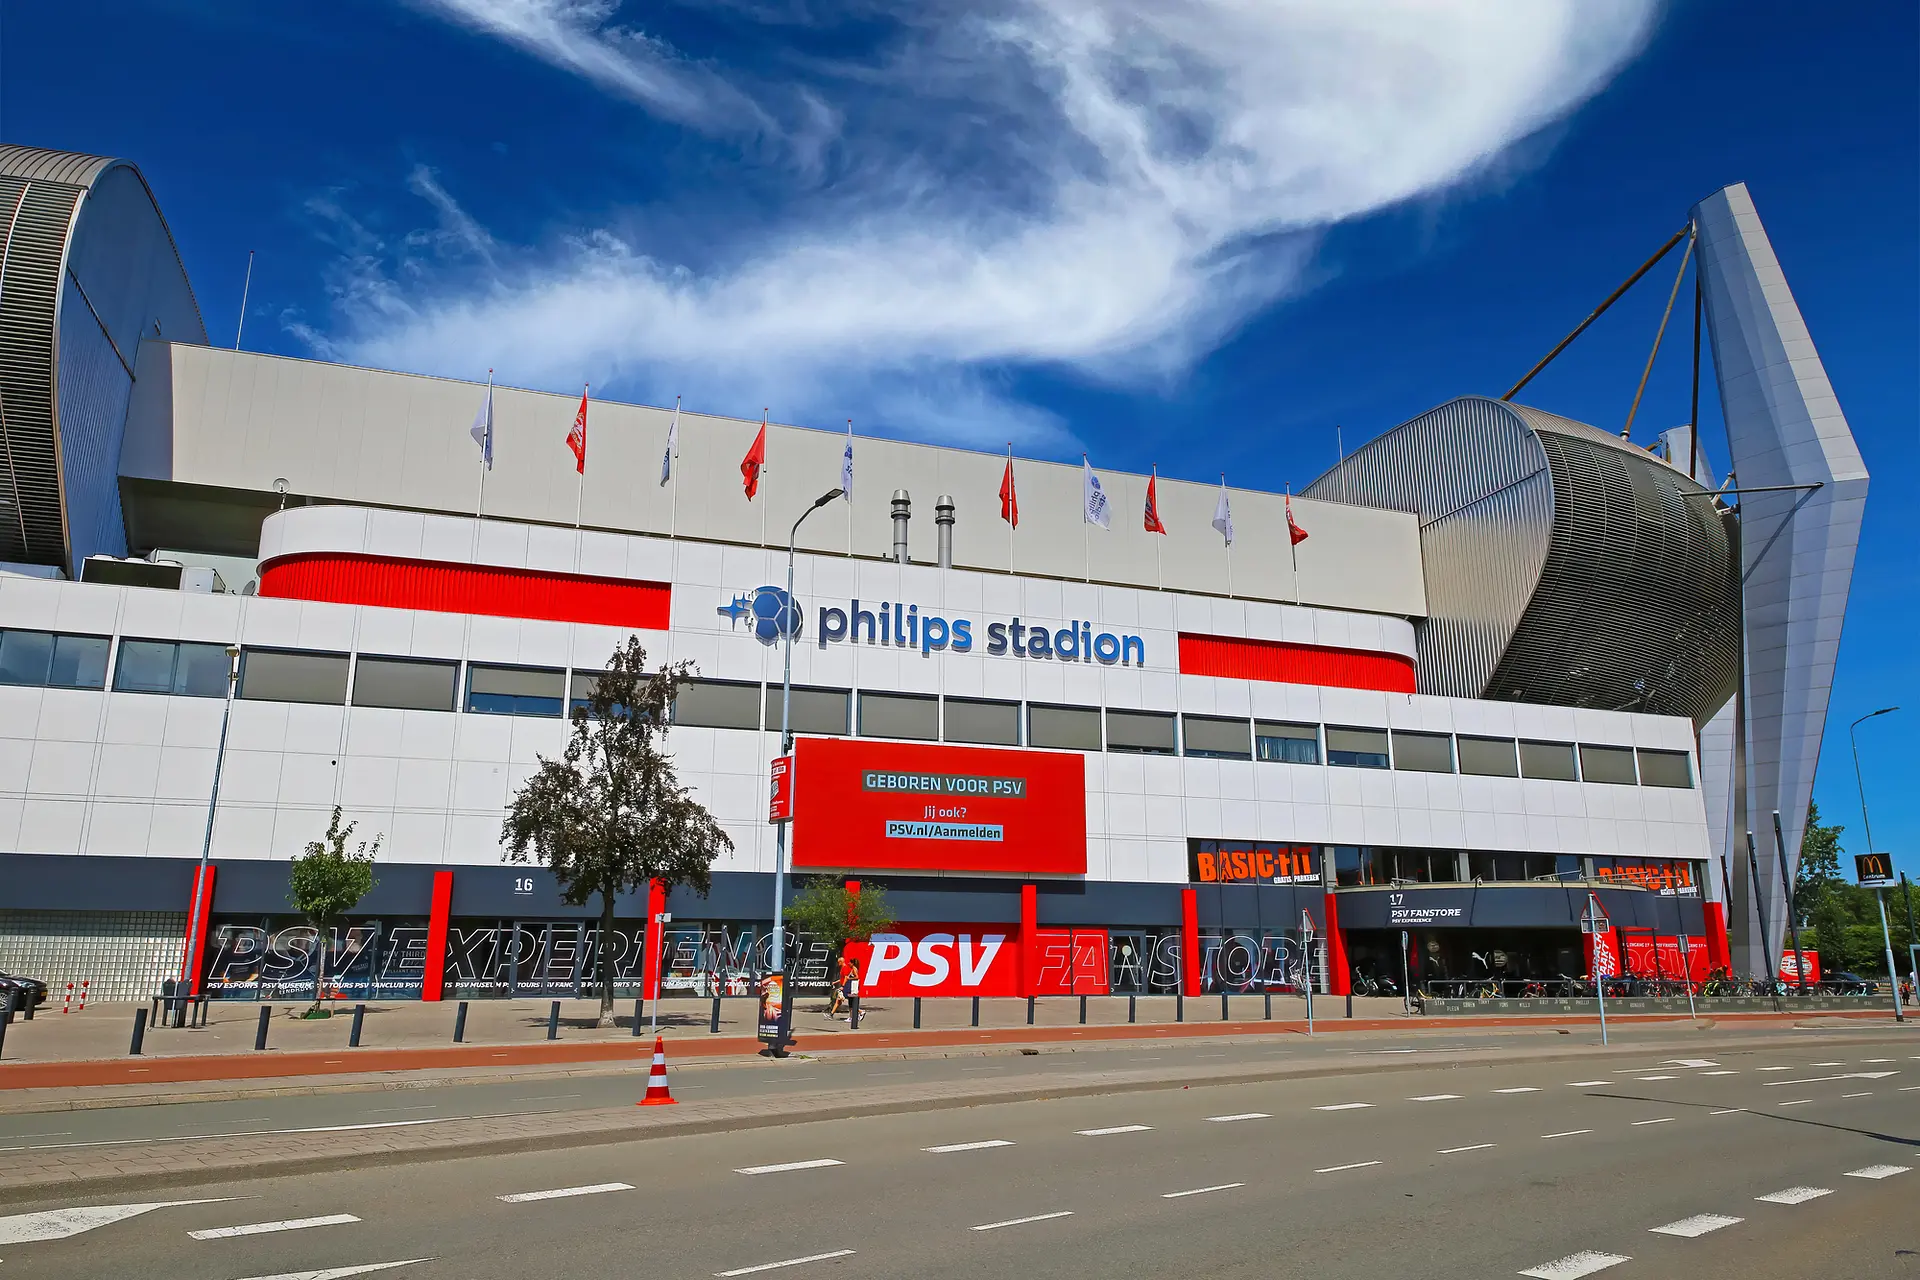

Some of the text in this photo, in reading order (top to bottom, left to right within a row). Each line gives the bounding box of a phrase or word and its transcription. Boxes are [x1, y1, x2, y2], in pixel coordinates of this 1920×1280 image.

[818, 598, 1145, 668] philips stadion
[866, 773, 1022, 795] GEBOREN VOOR PSV
[923, 806, 967, 819] Jij ook?
[889, 823, 1001, 839] PSV.nl/Aanmelden
[515, 878, 533, 891] 16
[1389, 893, 1404, 905] 17
[1391, 908, 1462, 918] PSV FANSTORE
[207, 926, 376, 980] PSV
[863, 932, 1330, 987] PSV FANSTORE
